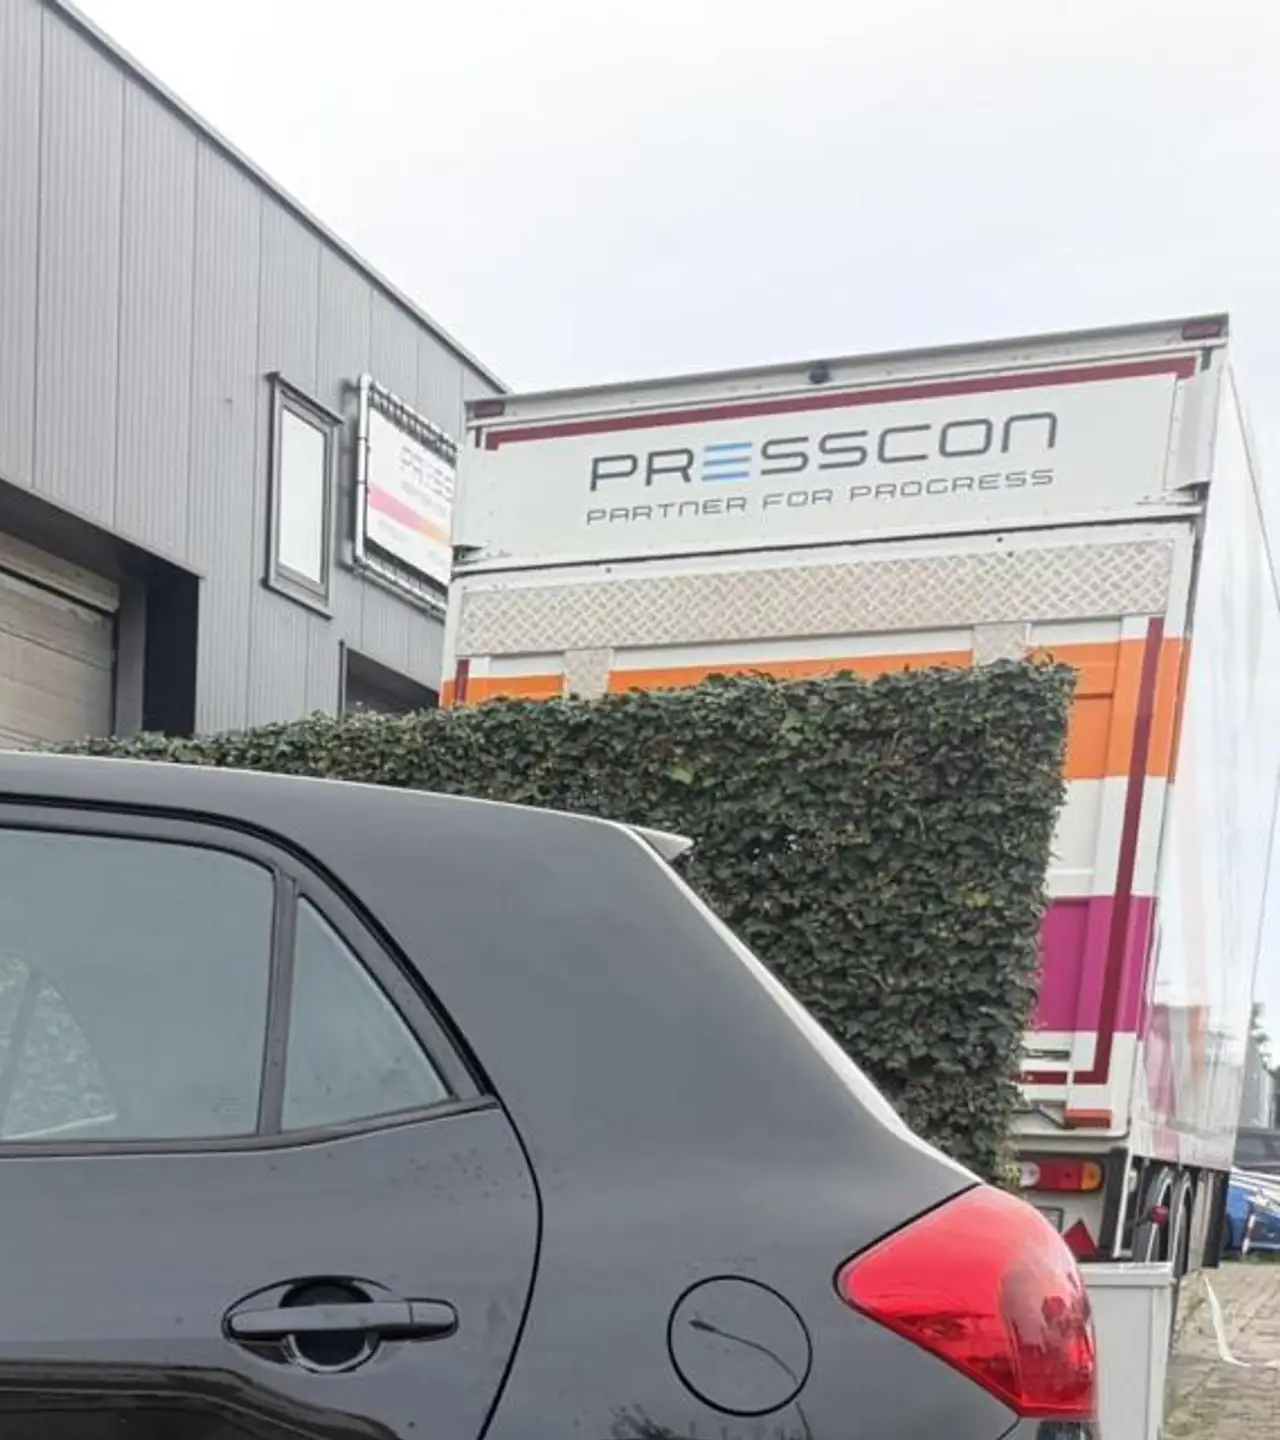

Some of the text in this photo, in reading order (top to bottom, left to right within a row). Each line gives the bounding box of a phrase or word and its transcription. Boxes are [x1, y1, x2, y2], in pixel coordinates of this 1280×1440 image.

[590, 411, 1059, 493] PRESSCON
[586, 468, 1054, 525] PARTNER FOR PROGRESS
